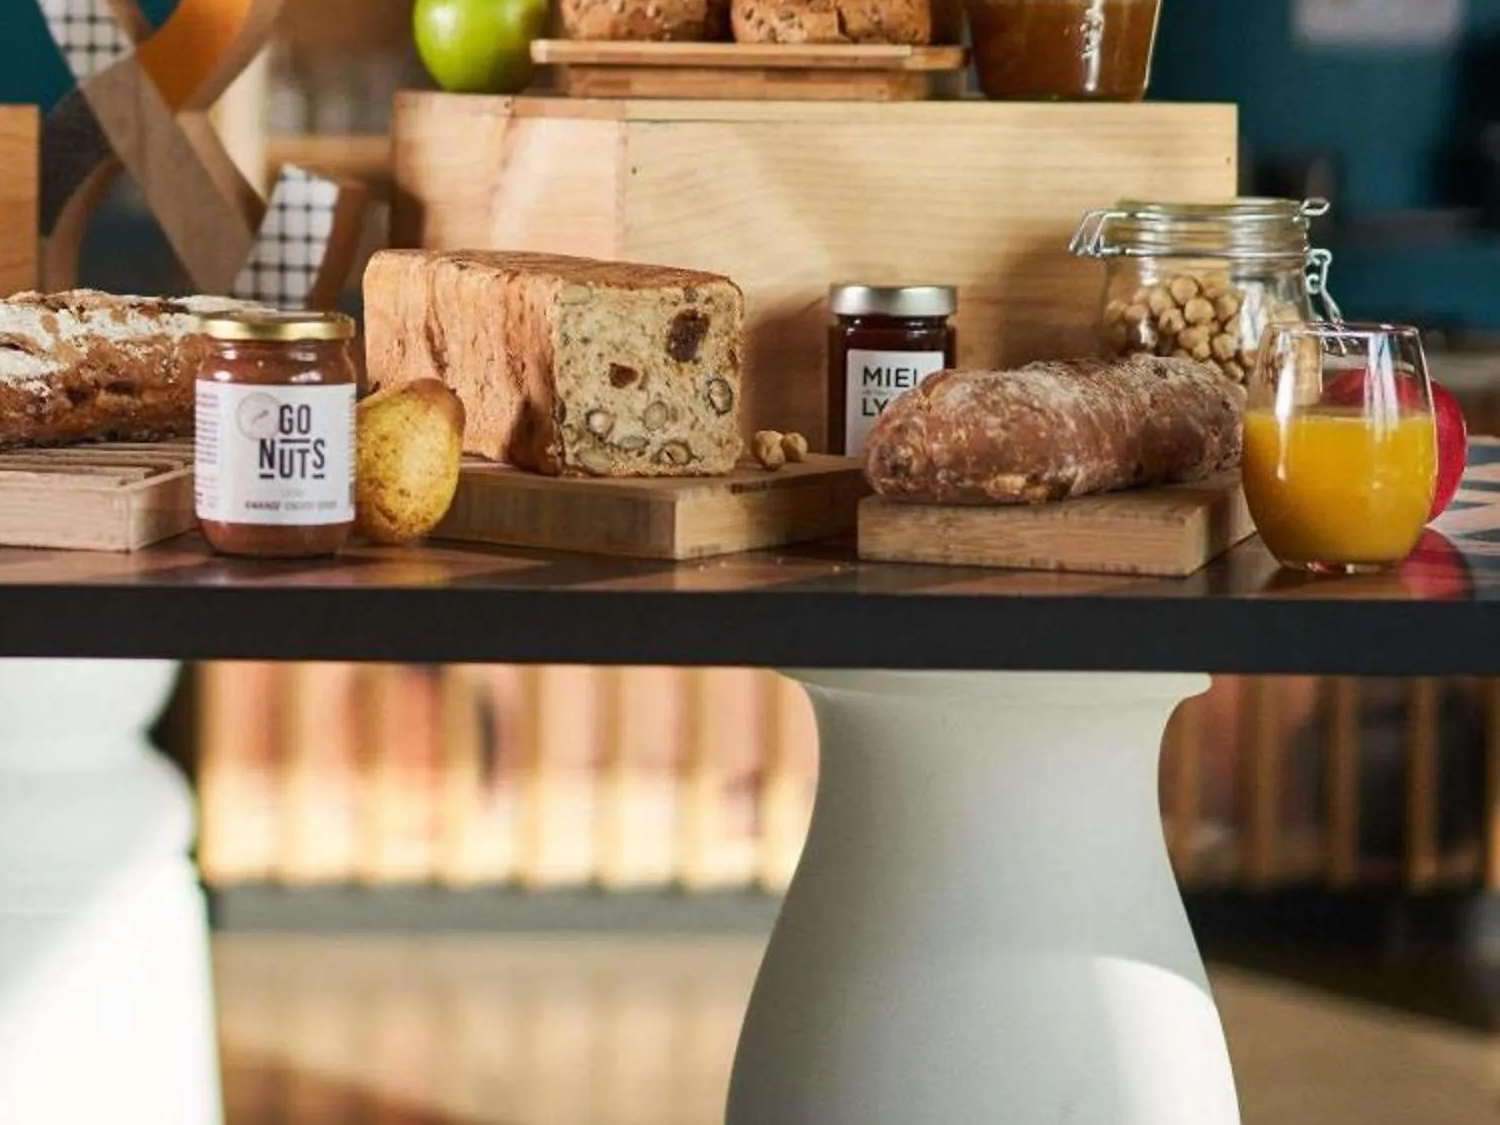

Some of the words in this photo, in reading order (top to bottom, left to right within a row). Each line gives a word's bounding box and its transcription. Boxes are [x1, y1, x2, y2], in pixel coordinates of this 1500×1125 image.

[278, 403, 311, 436] GO
[861, 397, 890, 417] LY
[258, 438, 326, 479] NUTS
